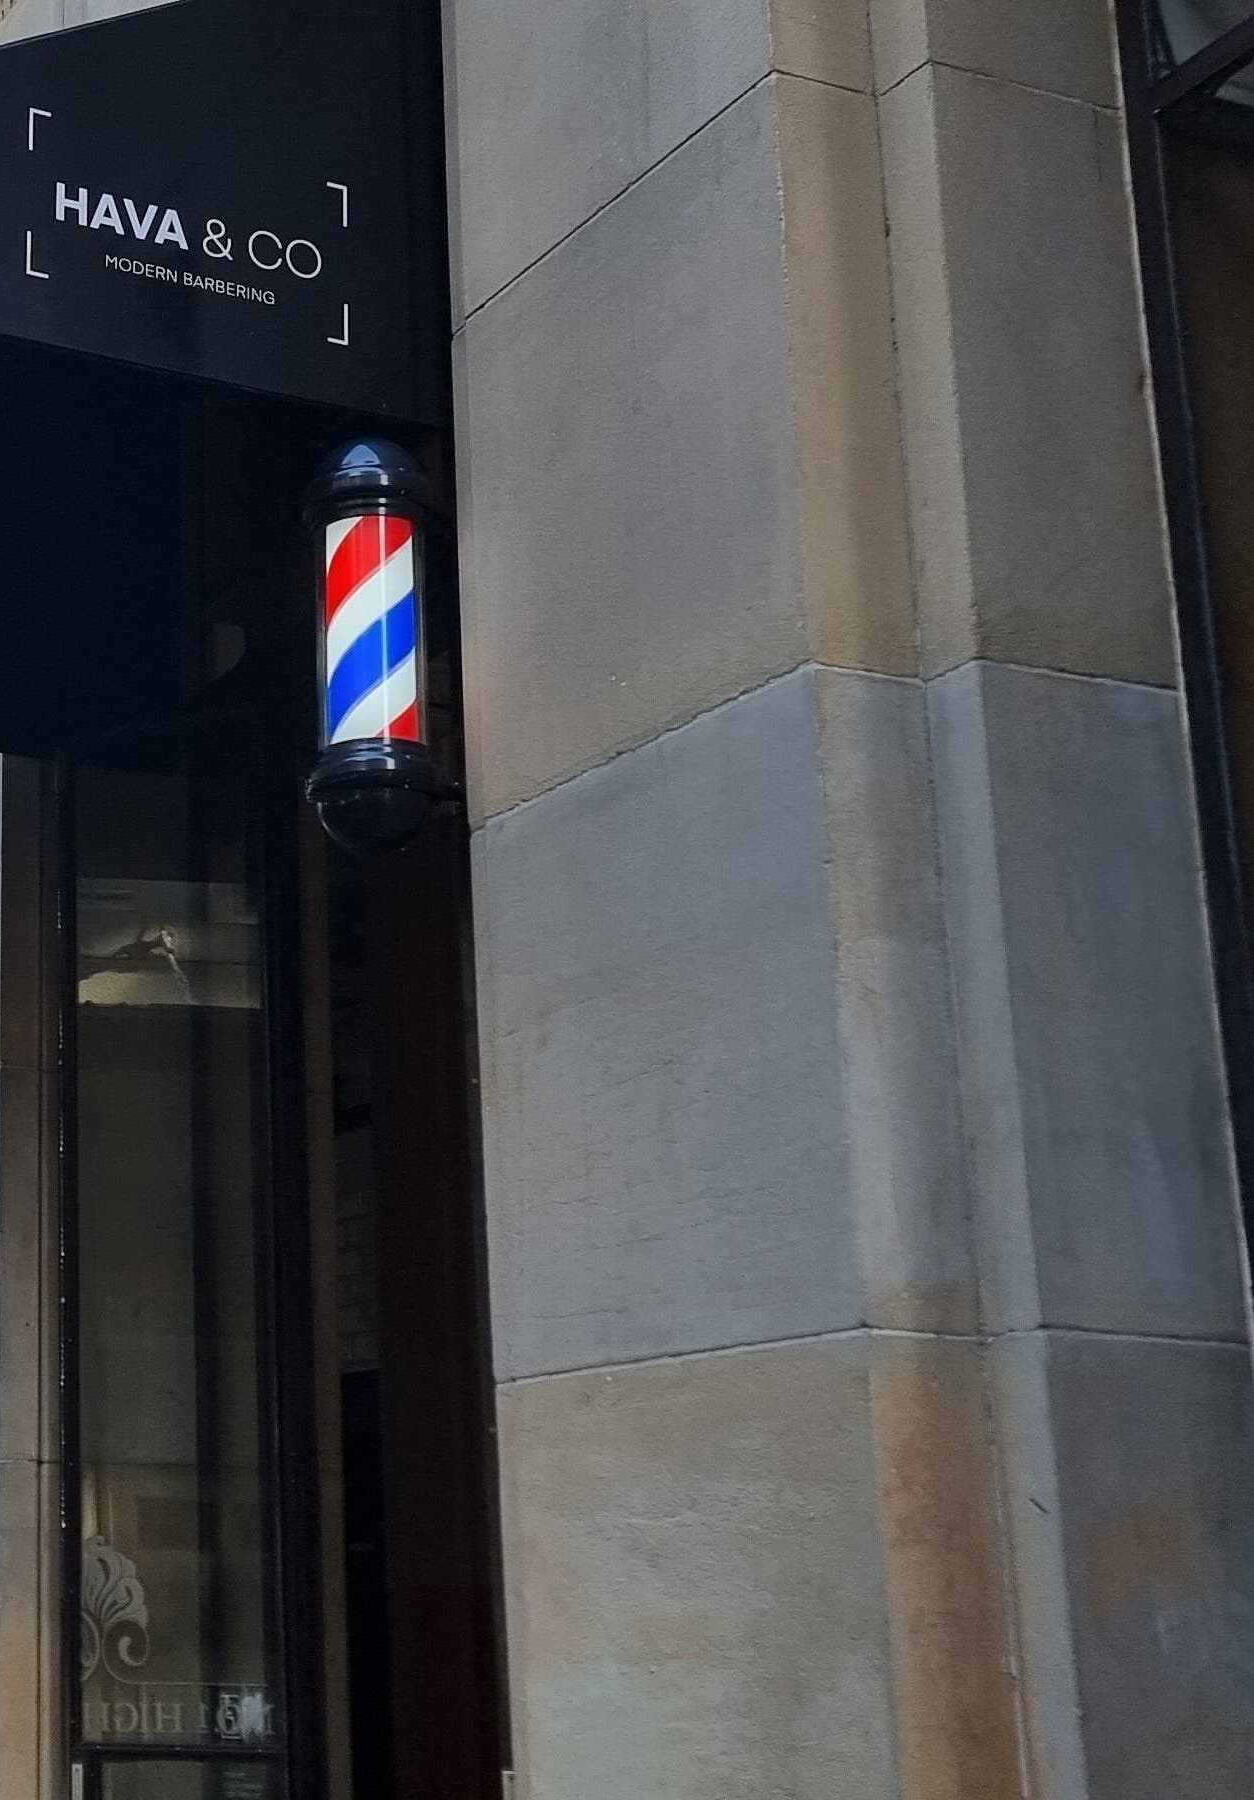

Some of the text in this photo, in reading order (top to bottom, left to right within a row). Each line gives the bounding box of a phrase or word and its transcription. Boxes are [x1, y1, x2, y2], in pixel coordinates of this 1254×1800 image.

[55, 182, 323, 279] HAVA & CO
[105, 254, 276, 305] MODERN BARBERING
